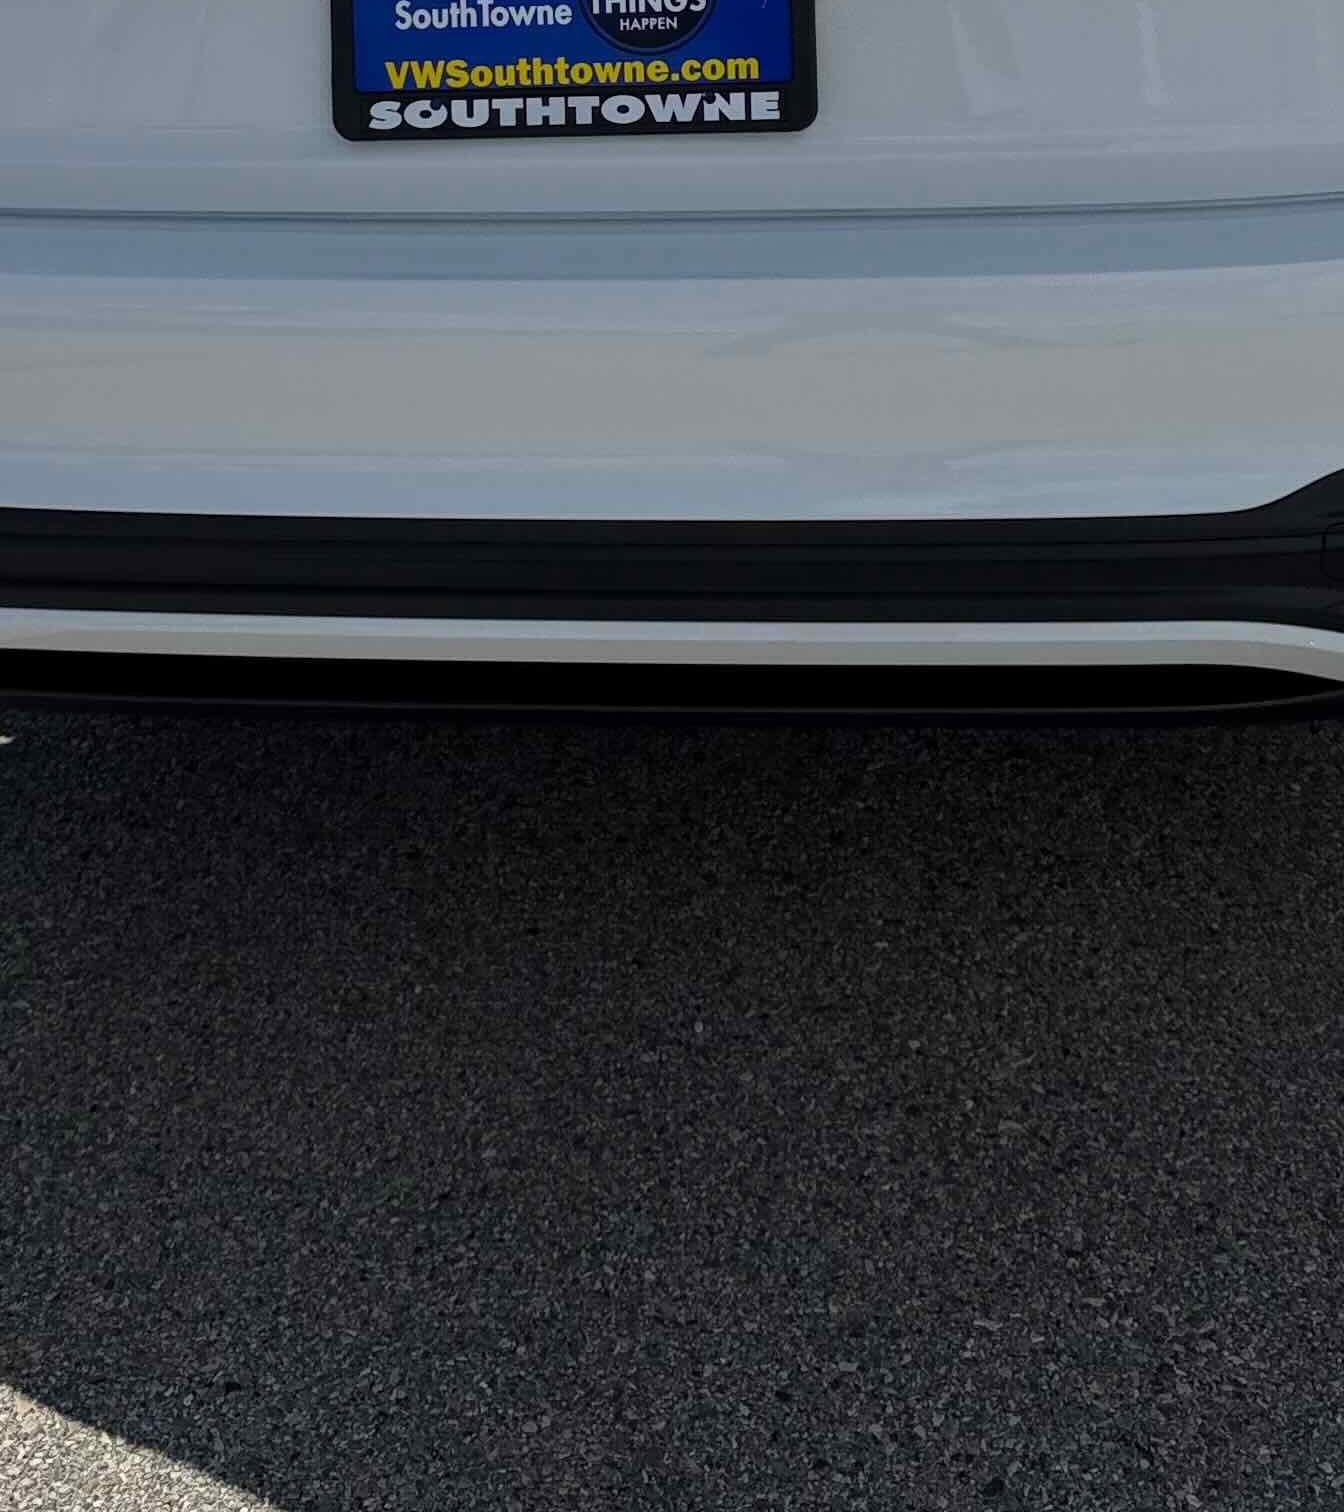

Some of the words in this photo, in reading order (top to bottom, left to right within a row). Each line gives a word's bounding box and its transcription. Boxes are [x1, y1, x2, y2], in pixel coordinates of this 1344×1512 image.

[620, 17, 678, 31] HAPPEN
[384, 56, 759, 89] VWSouthtowne.com
[368, 91, 780, 130] SOUTHTOWNE
